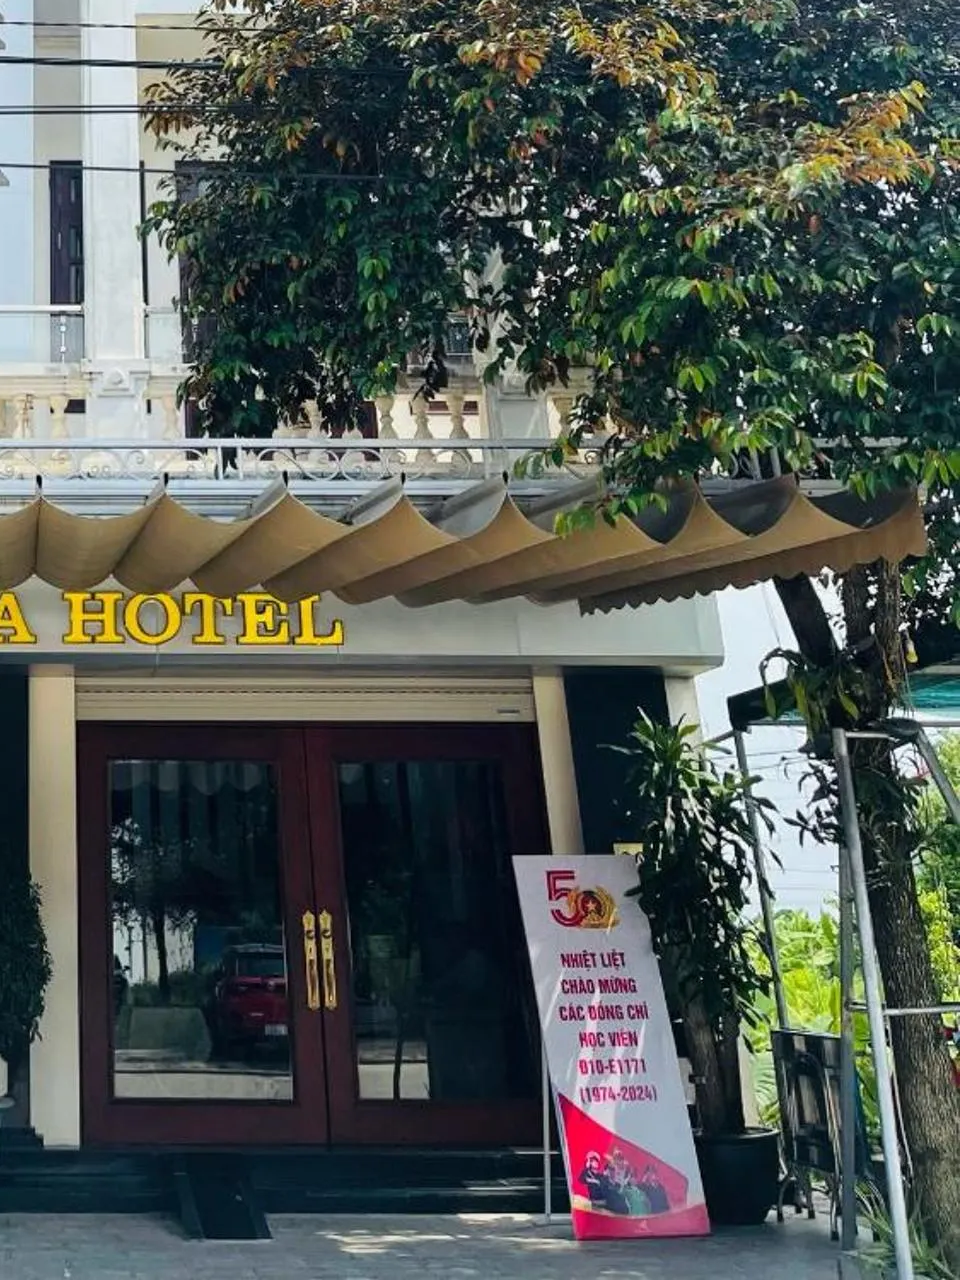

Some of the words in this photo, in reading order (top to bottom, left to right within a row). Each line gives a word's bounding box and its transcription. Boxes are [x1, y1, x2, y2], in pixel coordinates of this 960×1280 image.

[62, 589, 346, 647] HOTEL
[560, 949, 597, 971] NHIỆT
[600, 949, 626, 970] LIỆT
[561, 976, 596, 994] CHÀO
[559, 1003, 585, 1021] CÁC
